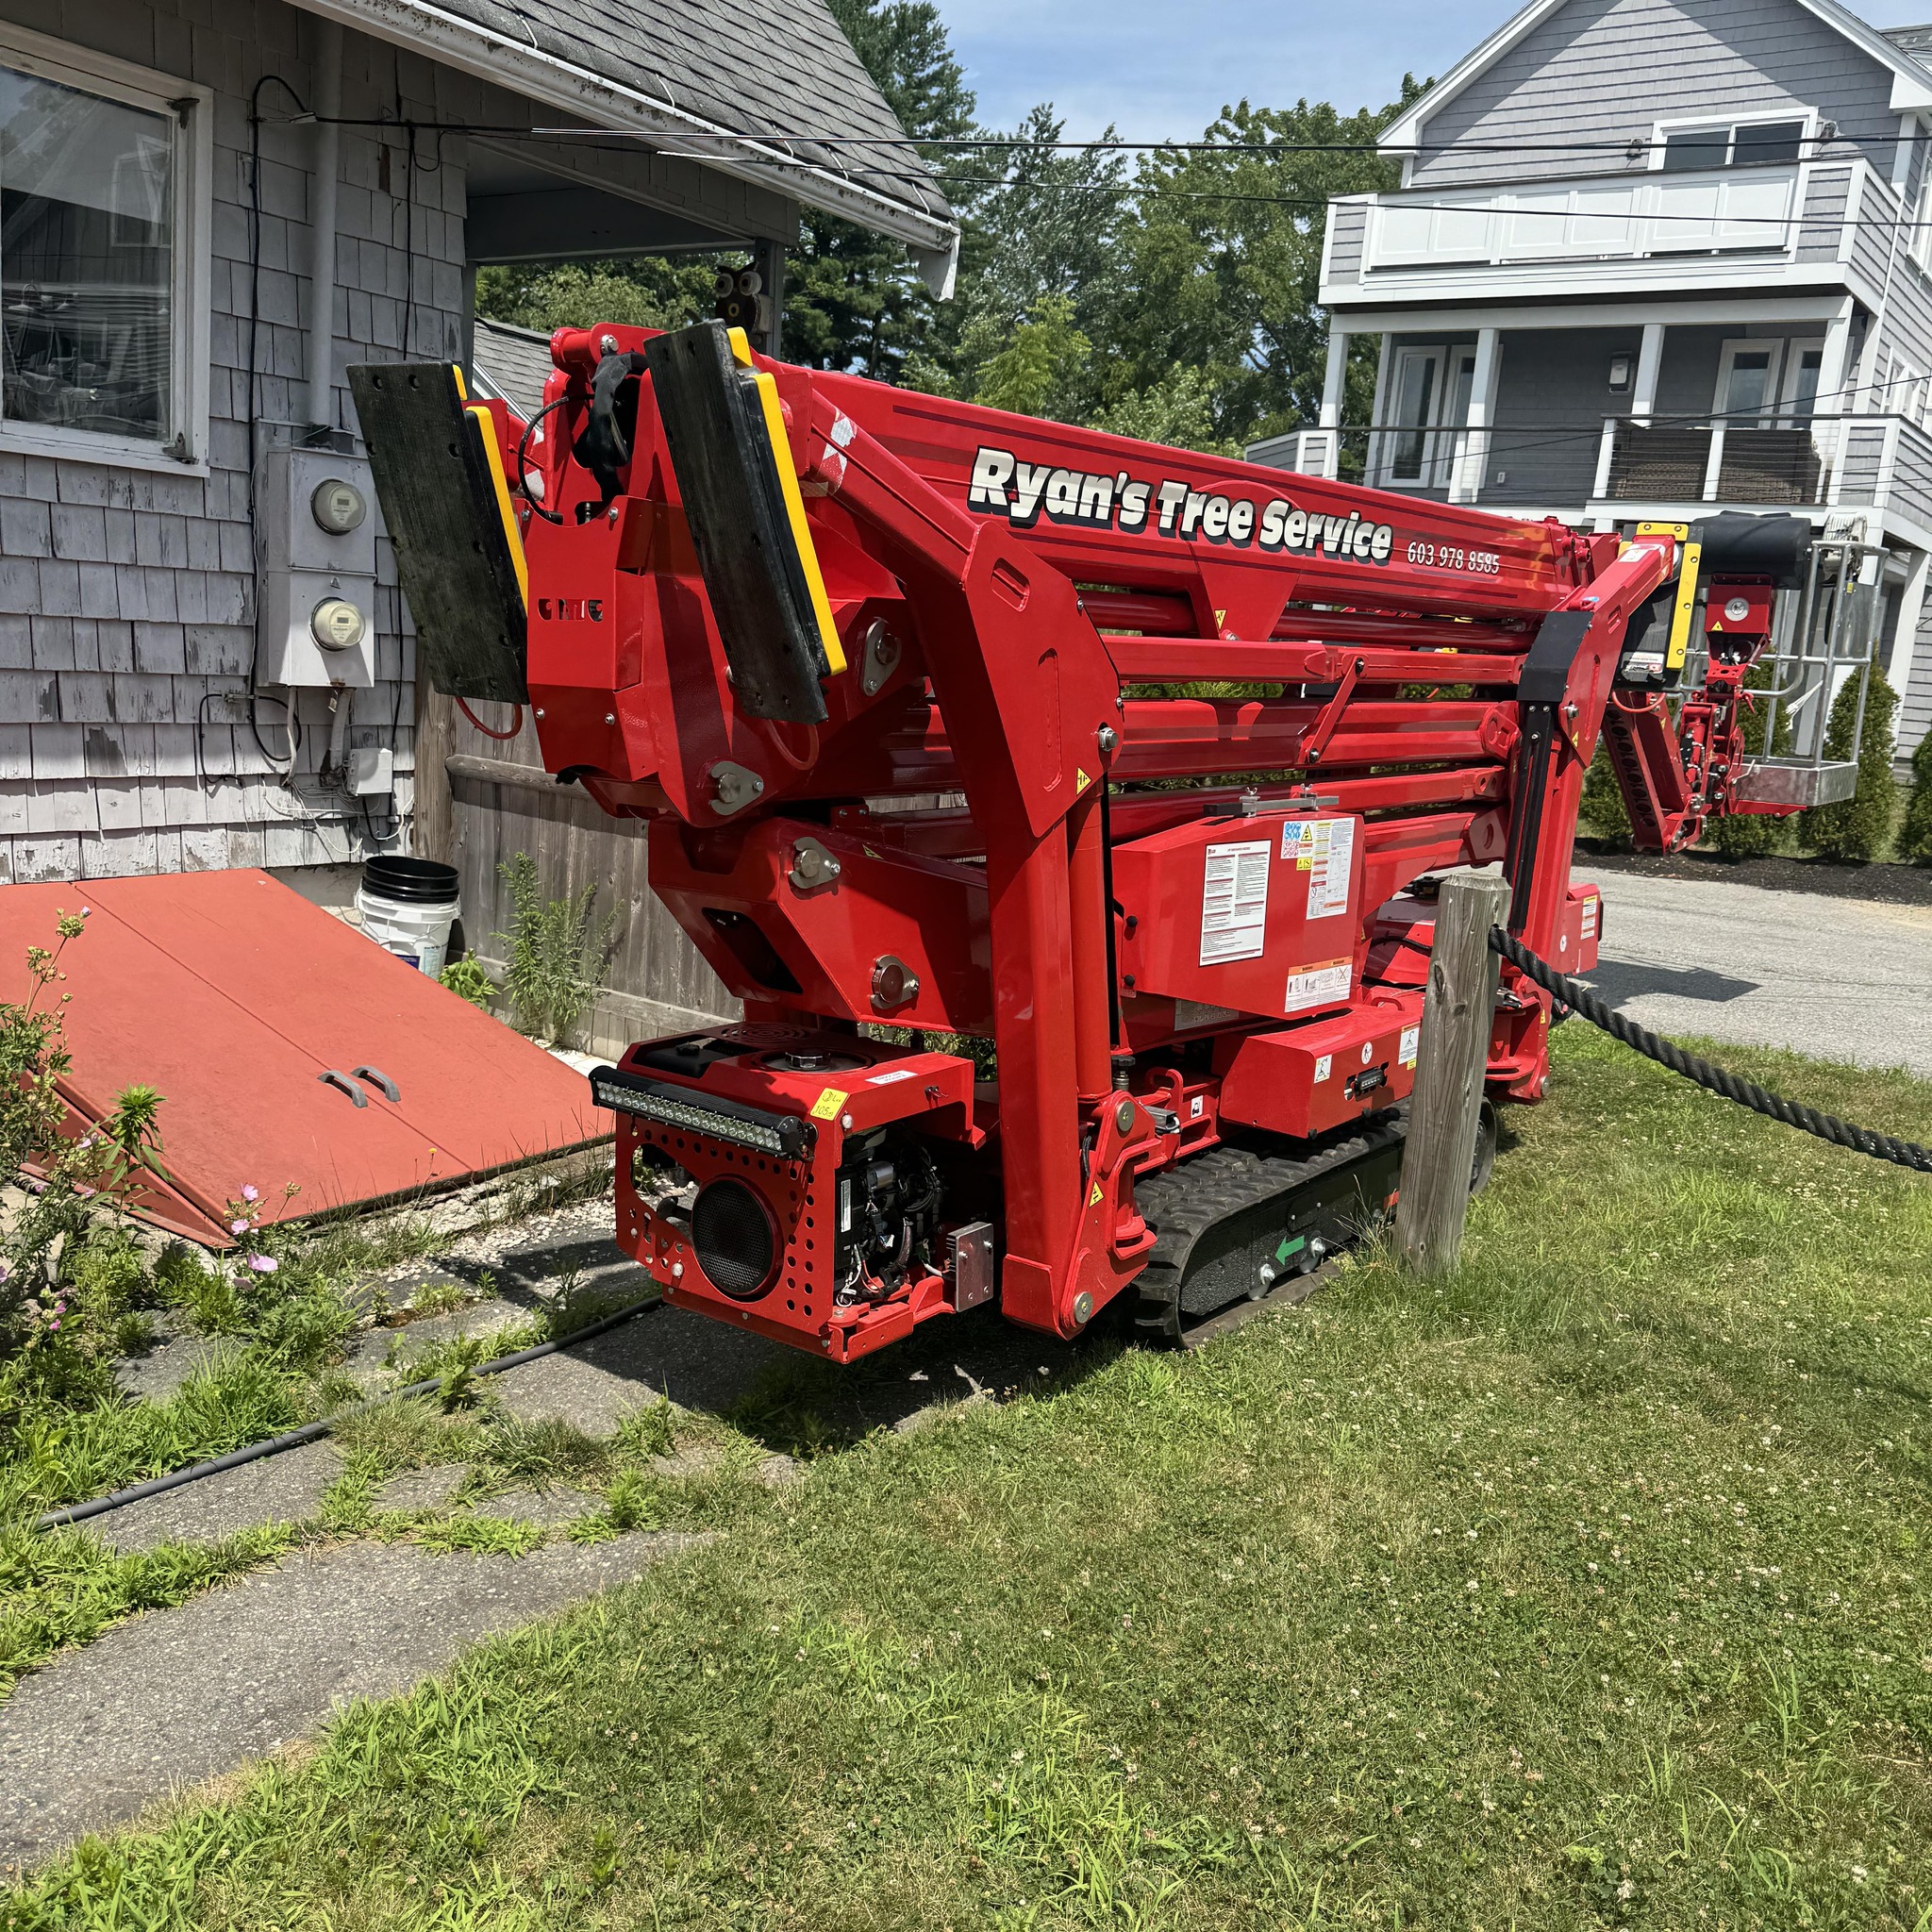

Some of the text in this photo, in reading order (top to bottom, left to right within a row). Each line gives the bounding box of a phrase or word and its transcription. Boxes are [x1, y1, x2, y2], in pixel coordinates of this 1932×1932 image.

[967, 446, 1393, 561] Ryan's Tree Service
[1407, 541, 1501, 575] 603 978 8585
